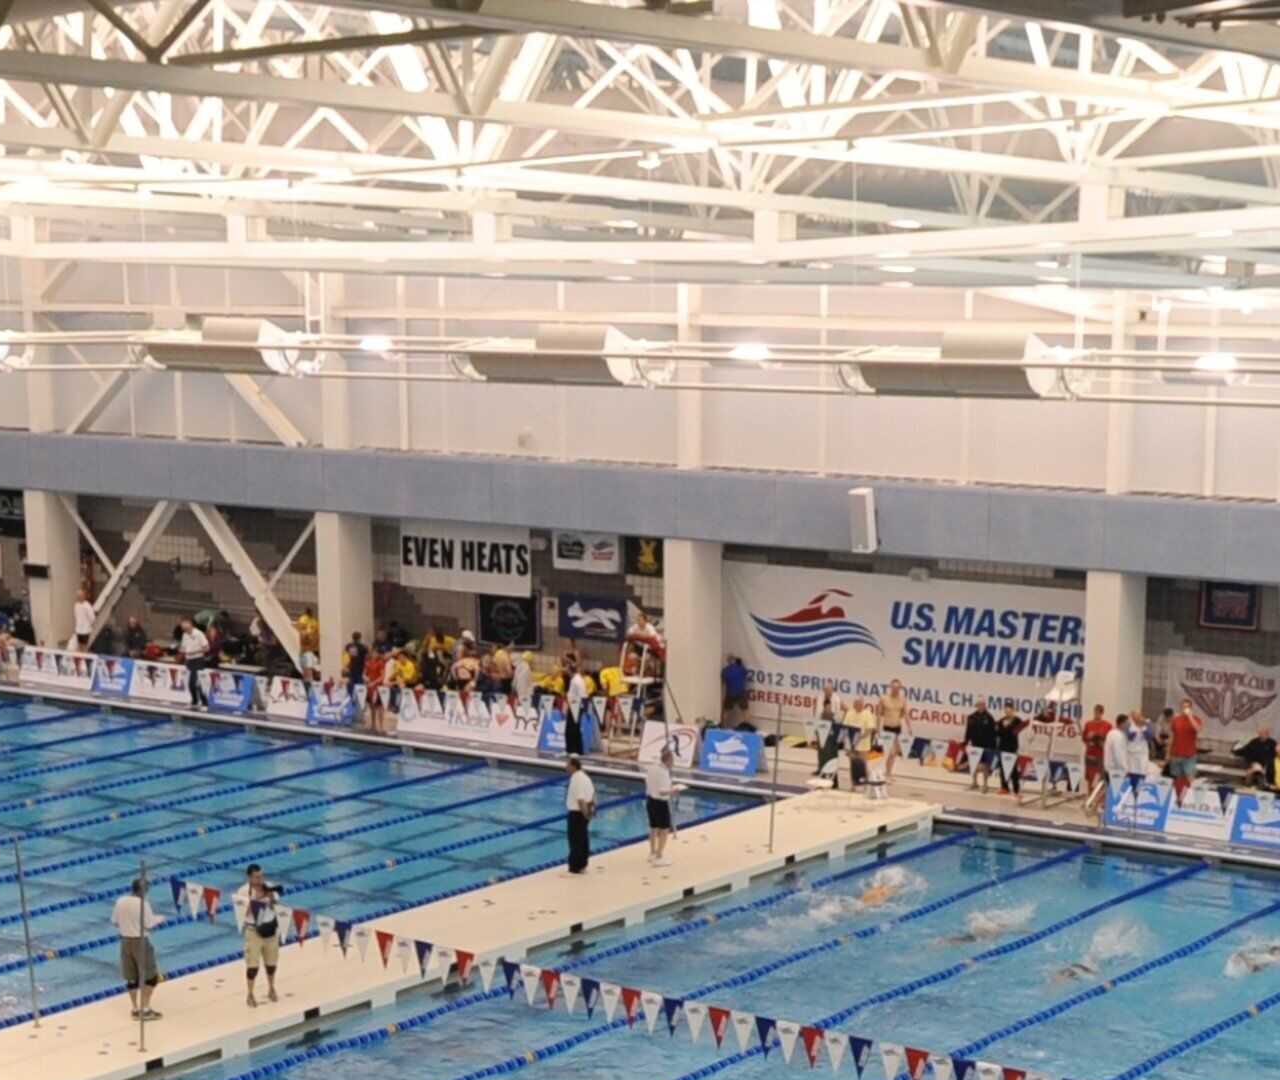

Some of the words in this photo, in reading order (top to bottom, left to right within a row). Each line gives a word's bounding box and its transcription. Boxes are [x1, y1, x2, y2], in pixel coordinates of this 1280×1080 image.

[402, 536, 454, 569] EVEN
[461, 540, 529, 576] HEATS
[890, 600, 937, 633] U.S.
[901, 636, 1085, 679] SWIMMING
[747, 668, 784, 687] 2012
